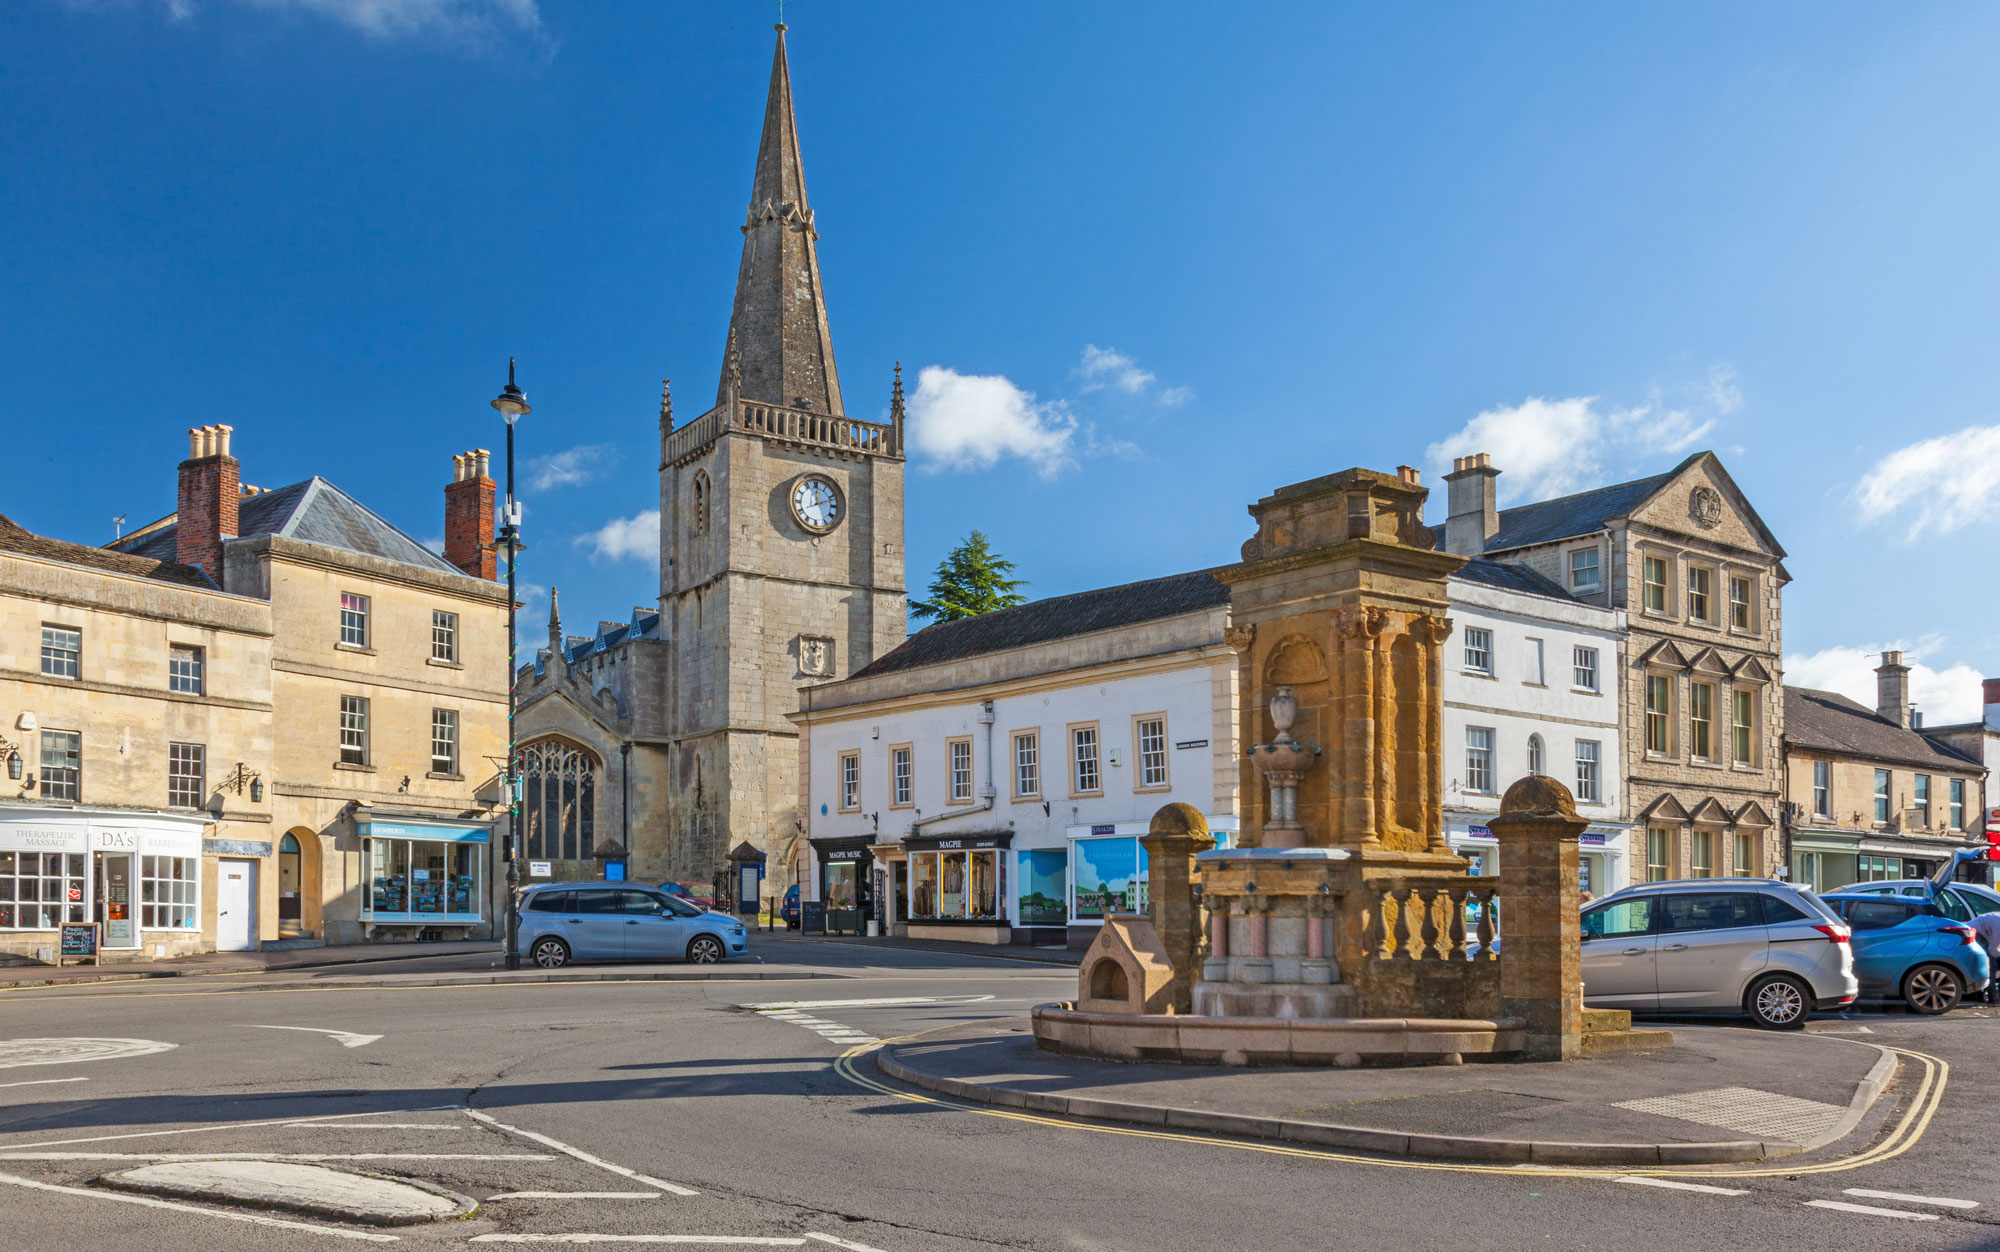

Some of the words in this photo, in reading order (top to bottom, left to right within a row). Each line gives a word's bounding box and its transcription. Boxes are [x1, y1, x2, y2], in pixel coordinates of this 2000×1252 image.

[16, 829, 77, 839] THERAPEUTIC
[373, 826, 405, 834] HUMBERTS
[1092, 825, 1114, 834] STRAKERS
[25, 838, 68, 847] MASSAGE
[102, 831, 134, 846] DA's
[148, 838, 192, 849] BARBERSHOP
[939, 840, 962, 848] MAGPIE
[829, 851, 846, 859] MAGPIE
[847, 850, 862, 858] MUSIC
